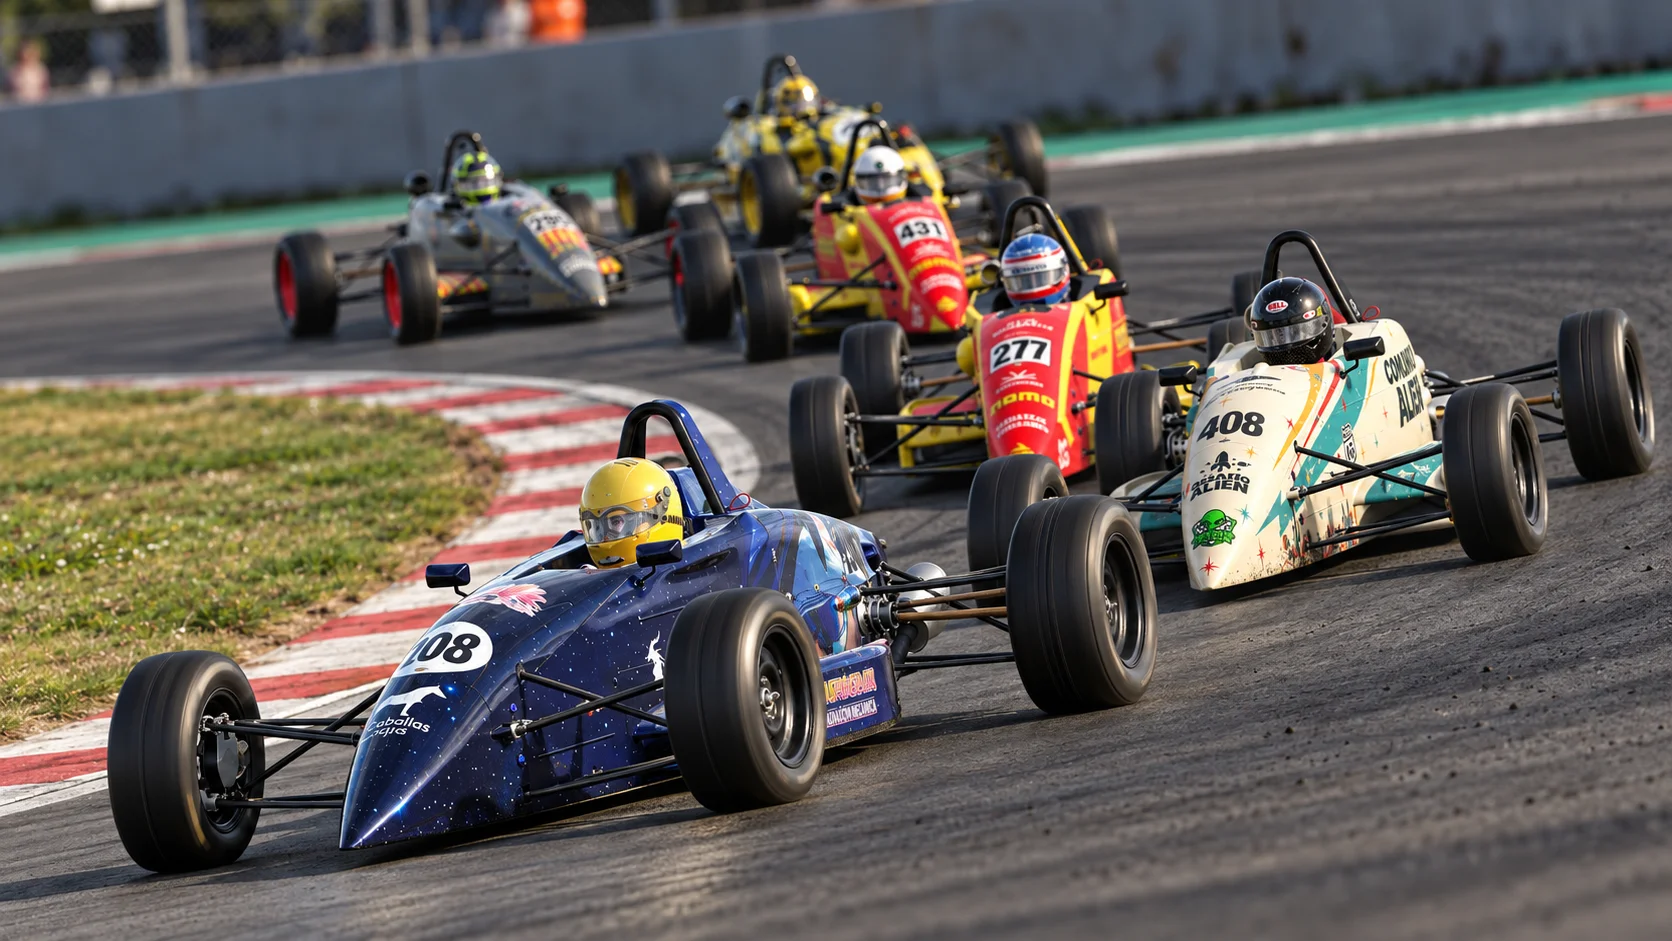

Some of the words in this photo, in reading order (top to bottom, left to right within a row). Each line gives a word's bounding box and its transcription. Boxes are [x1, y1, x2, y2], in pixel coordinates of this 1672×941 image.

[901, 221, 943, 239] 431
[993, 339, 1048, 369] 277
[1197, 410, 1266, 442] 408
[1190, 480, 1249, 502] ALIEN
